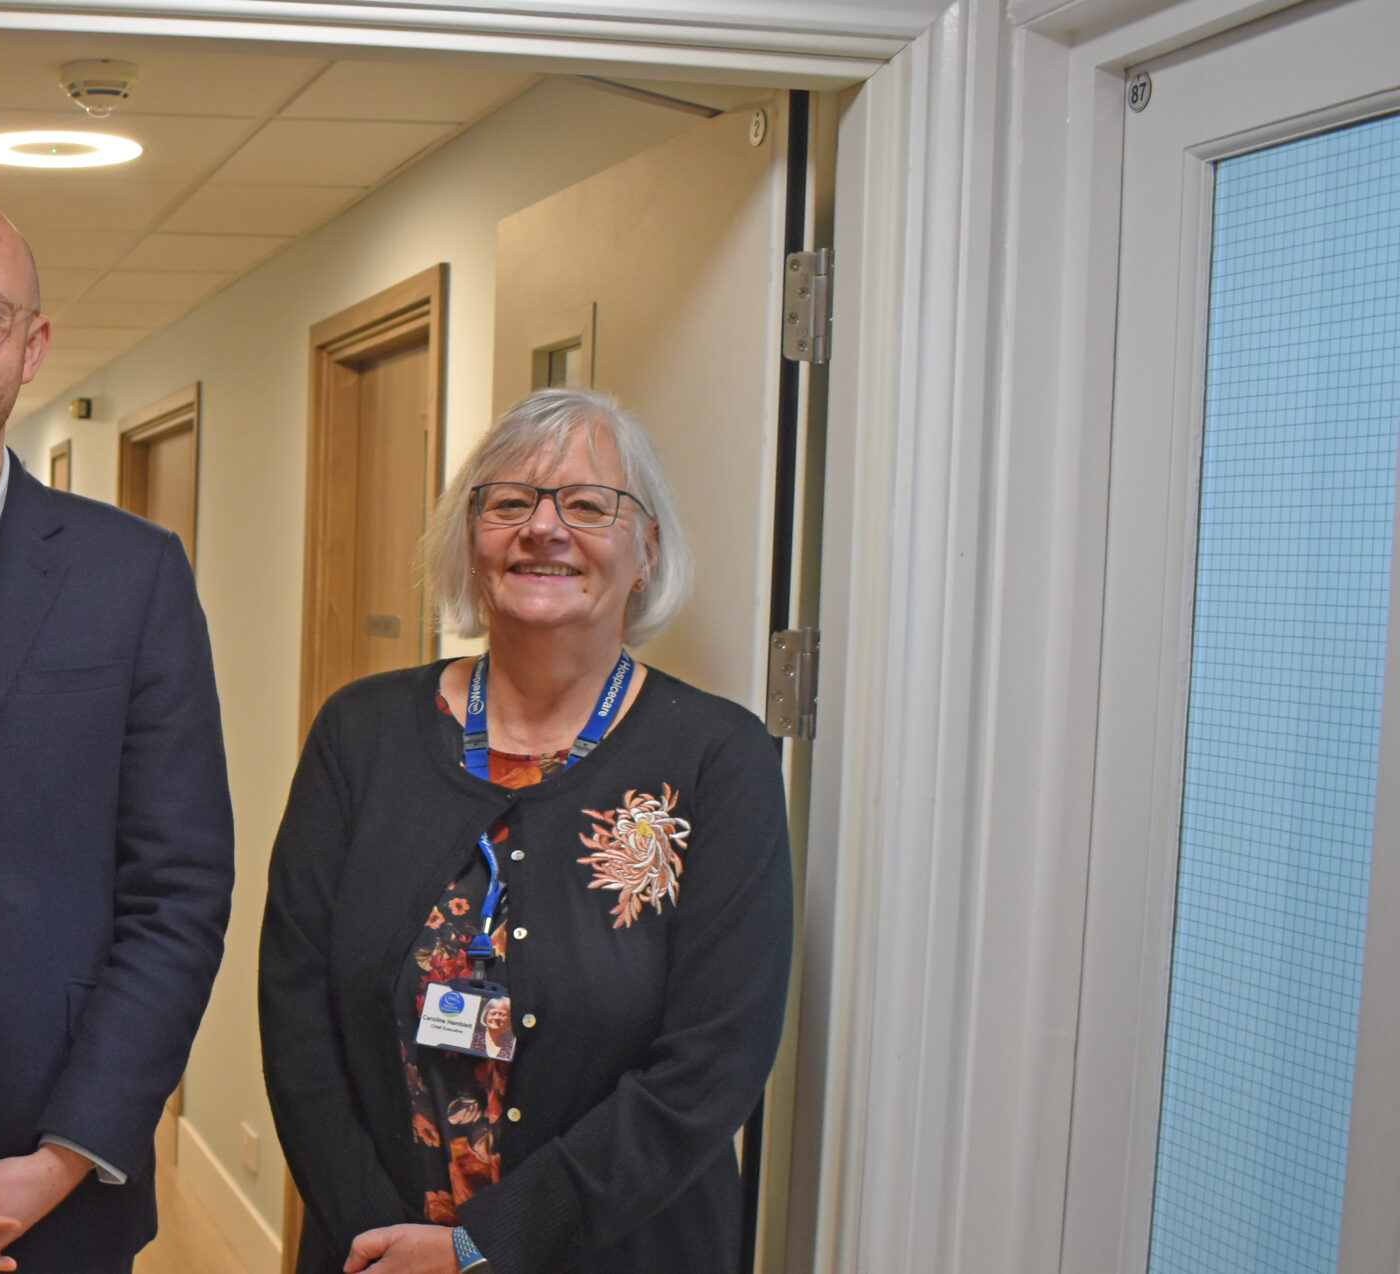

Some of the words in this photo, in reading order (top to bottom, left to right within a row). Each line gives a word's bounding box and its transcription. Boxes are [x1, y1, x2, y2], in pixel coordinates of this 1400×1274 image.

[1131, 82, 1147, 104] 87
[753, 119, 760, 138] 2
[598, 660, 631, 717] Hospicecare
